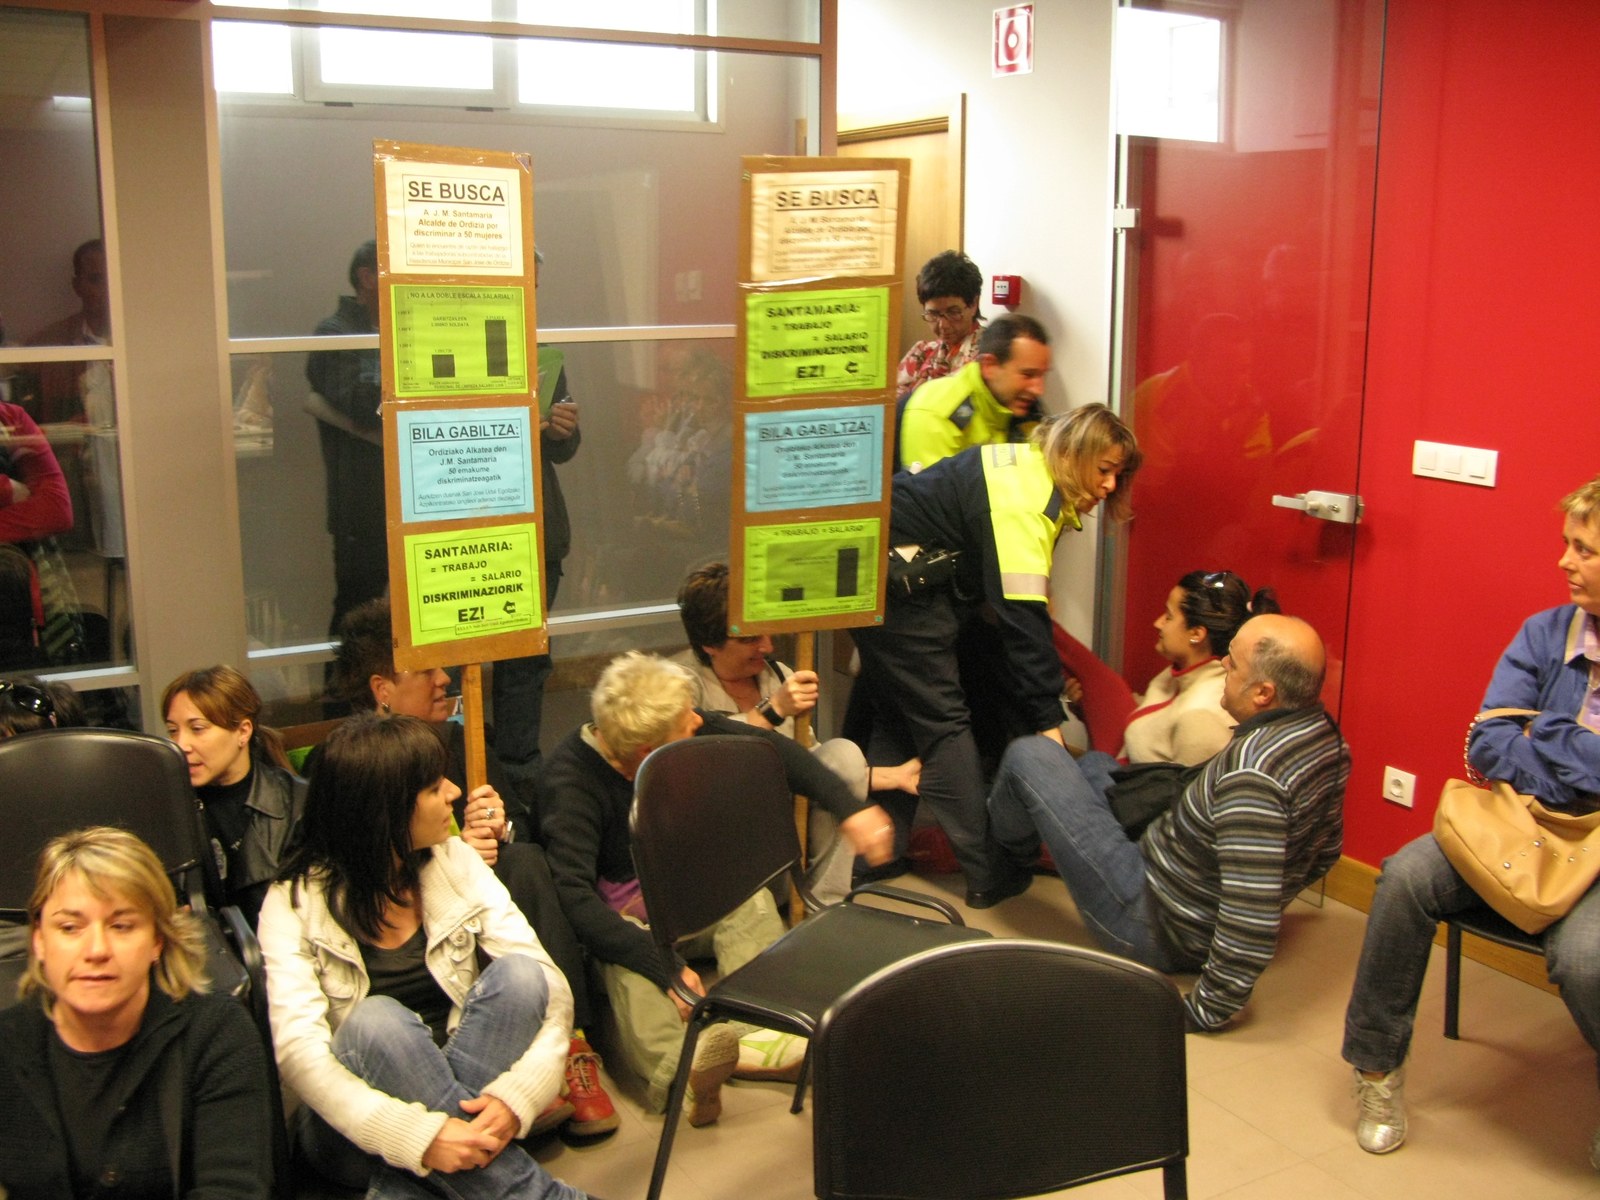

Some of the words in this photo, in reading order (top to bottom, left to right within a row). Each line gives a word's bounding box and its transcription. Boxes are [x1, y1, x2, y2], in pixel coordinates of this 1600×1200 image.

[408, 180, 433, 198] SE
[440, 182, 505, 202] BUSCA
[776, 191, 802, 207] SE
[809, 189, 880, 206] BUSCA
[452, 210, 493, 219] Santamaria
[418, 219, 446, 227] Alcalde
[448, 220, 457, 228] de
[459, 220, 484, 229] Ordizia
[414, 229, 455, 238] discriminar
[474, 232, 503, 241] mujeres
[824, 331, 869, 342] SALARIO
[796, 364, 825, 379] EZ!
[412, 427, 445, 440] BILA
[449, 424, 519, 438] GABILTZA:
[760, 426, 793, 439] BILA
[797, 421, 871, 437] GABILTZA:
[428, 448, 464, 457] Ordiziako
[466, 446, 492, 454] Alkatea
[494, 445, 507, 453] den
[457, 456, 497, 465] Santamaria
[458, 466, 490, 474] emakume
[437, 475, 501, 485] diskriminatzeagatik
[425, 541, 513, 560] SANTAMARIA:
[442, 560, 487, 573] TRABAJO
[482, 570, 522, 582] SALARIO
[423, 583, 524, 604] DISKRIMINAZIORIK
[458, 606, 485, 622] EZ!
